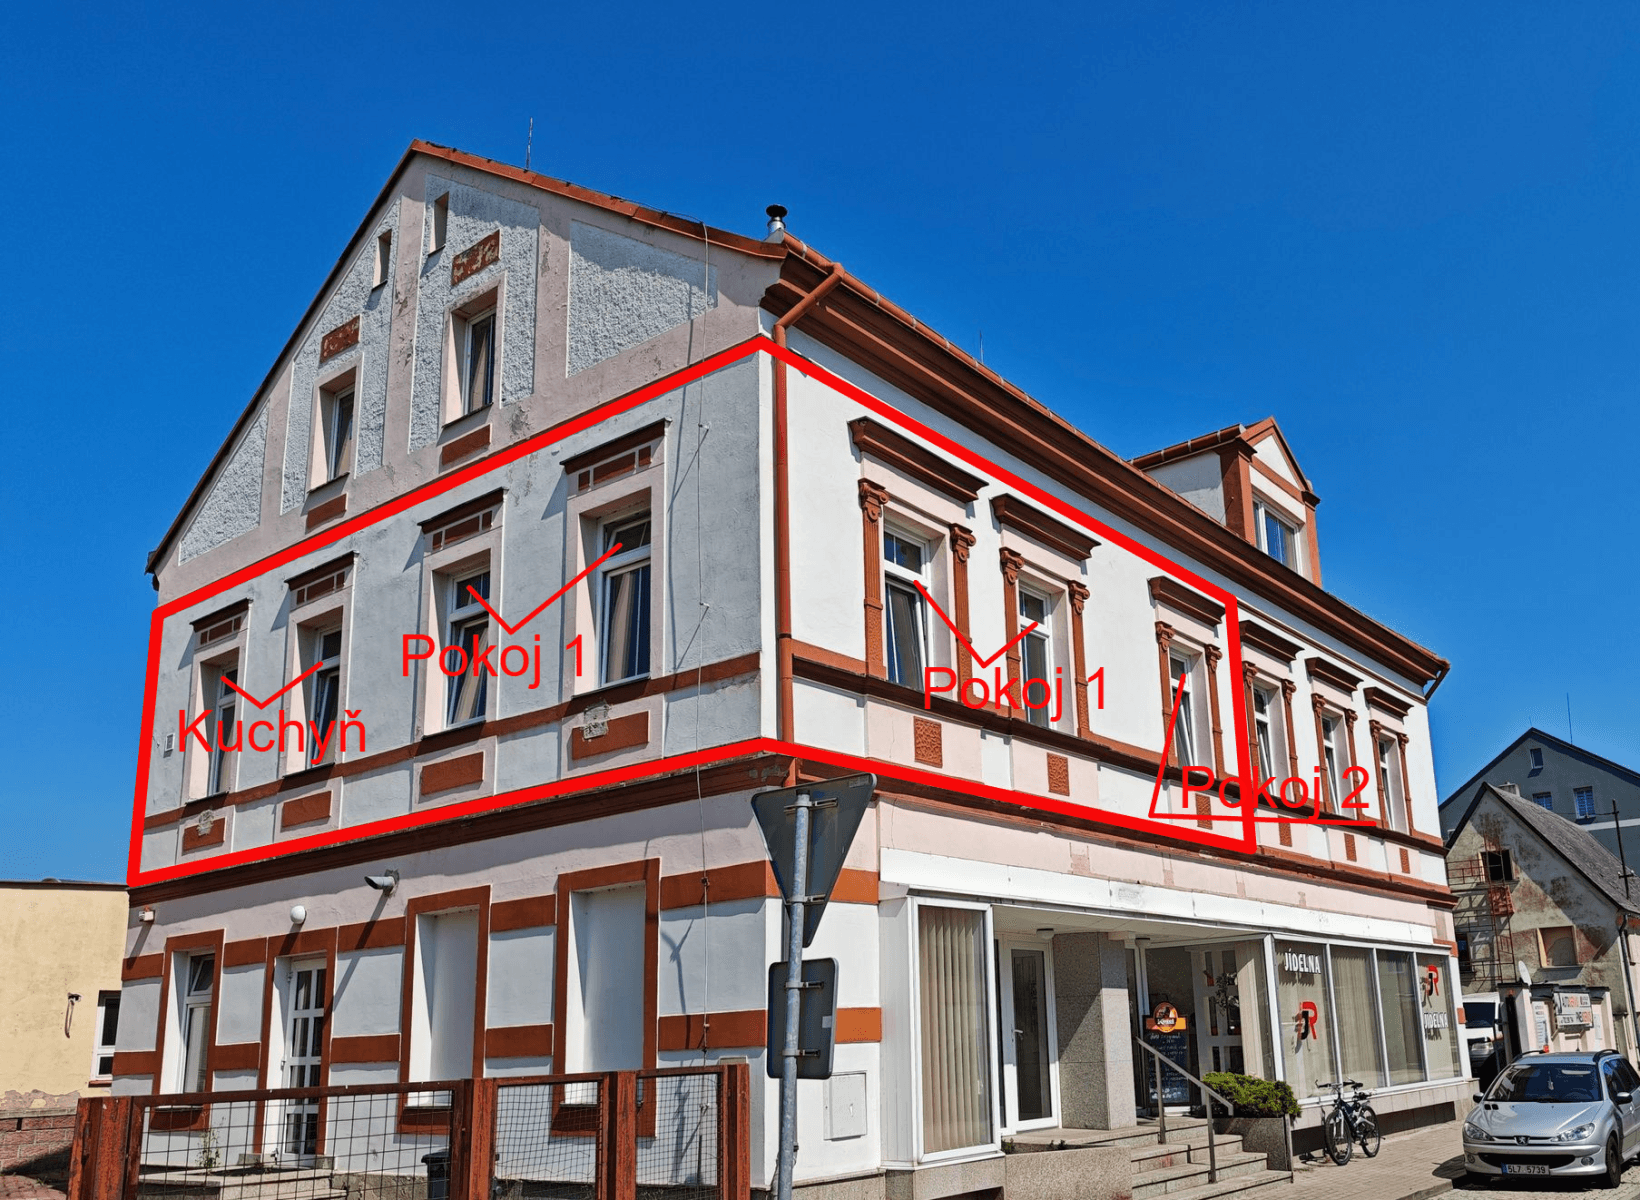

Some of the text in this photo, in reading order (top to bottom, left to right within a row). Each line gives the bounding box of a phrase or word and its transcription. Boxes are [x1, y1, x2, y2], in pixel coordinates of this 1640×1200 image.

[1285, 948, 1321, 974] JÍDELNA
[1508, 1165, 1546, 1174] 5L7 5739
